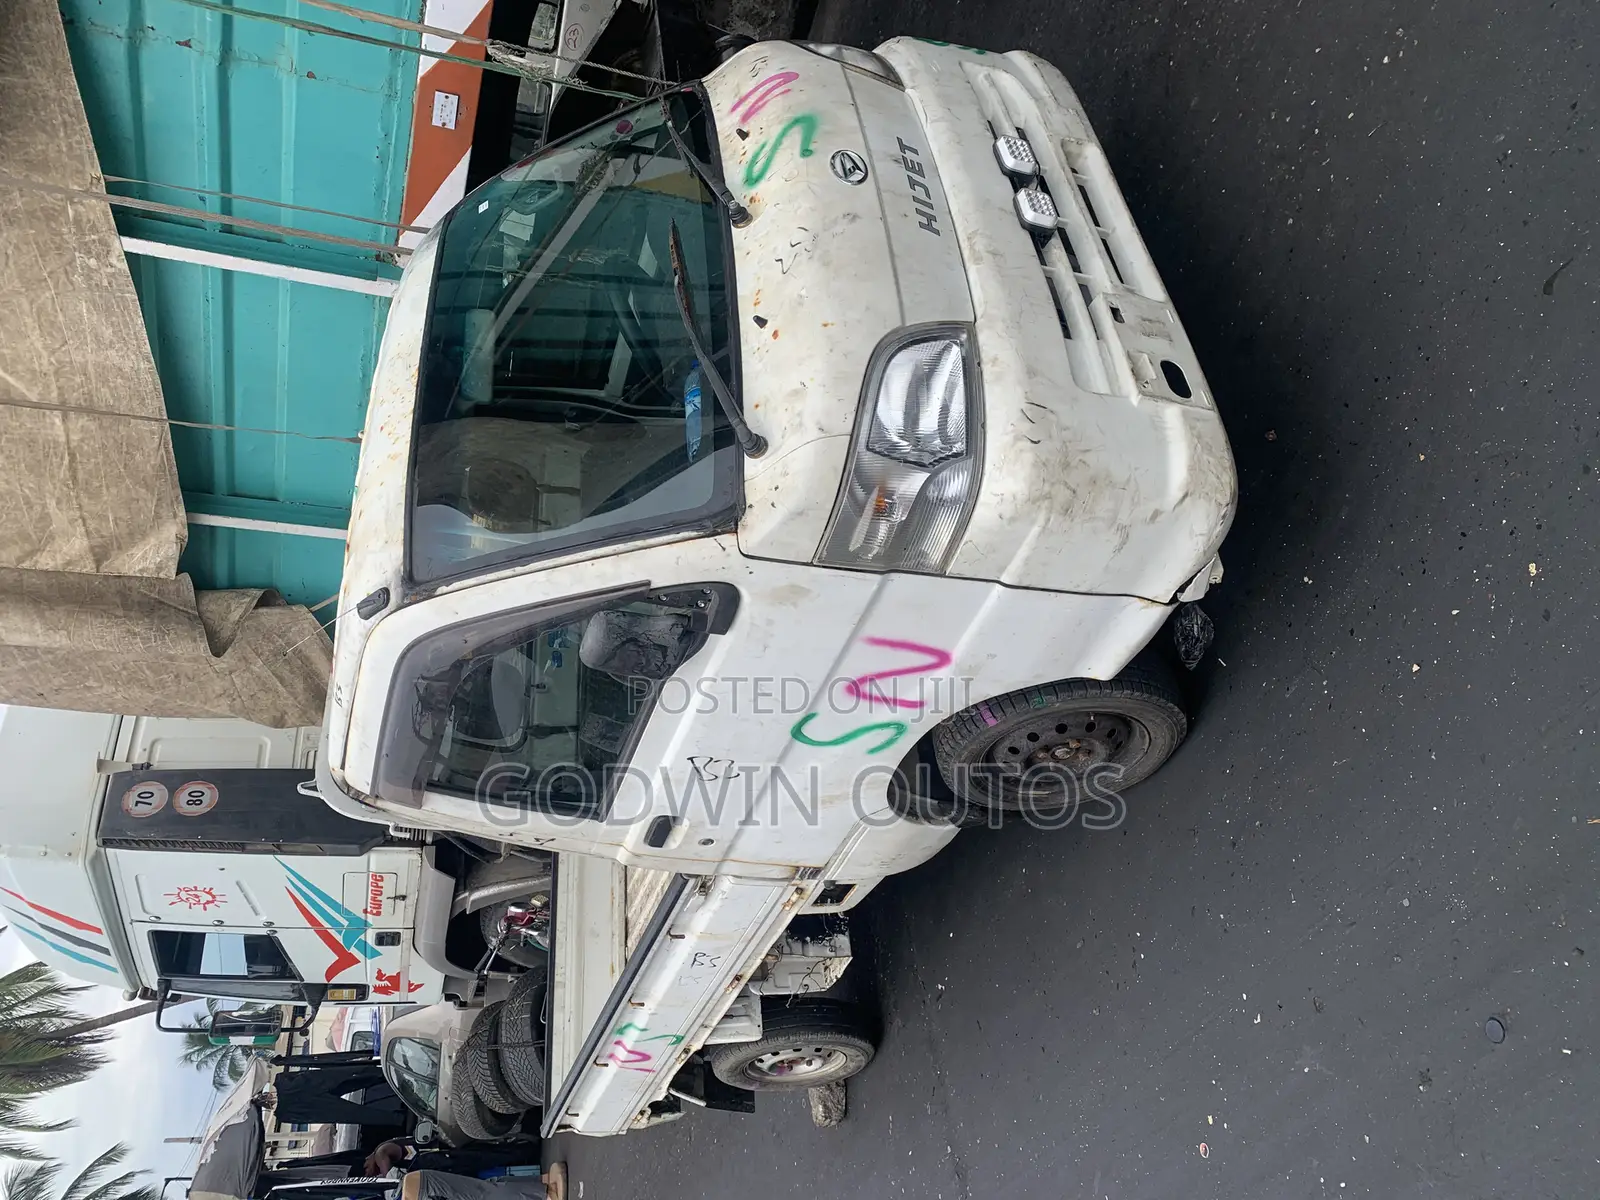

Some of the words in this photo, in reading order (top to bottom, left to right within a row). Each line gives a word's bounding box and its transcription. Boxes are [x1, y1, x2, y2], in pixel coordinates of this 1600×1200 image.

[568, 28, 579, 48] 23
[896, 136, 941, 236] HIJET
[134, 791, 155, 807] 70
[186, 790, 205, 806] 80
[362, 873, 384, 916] Europe
